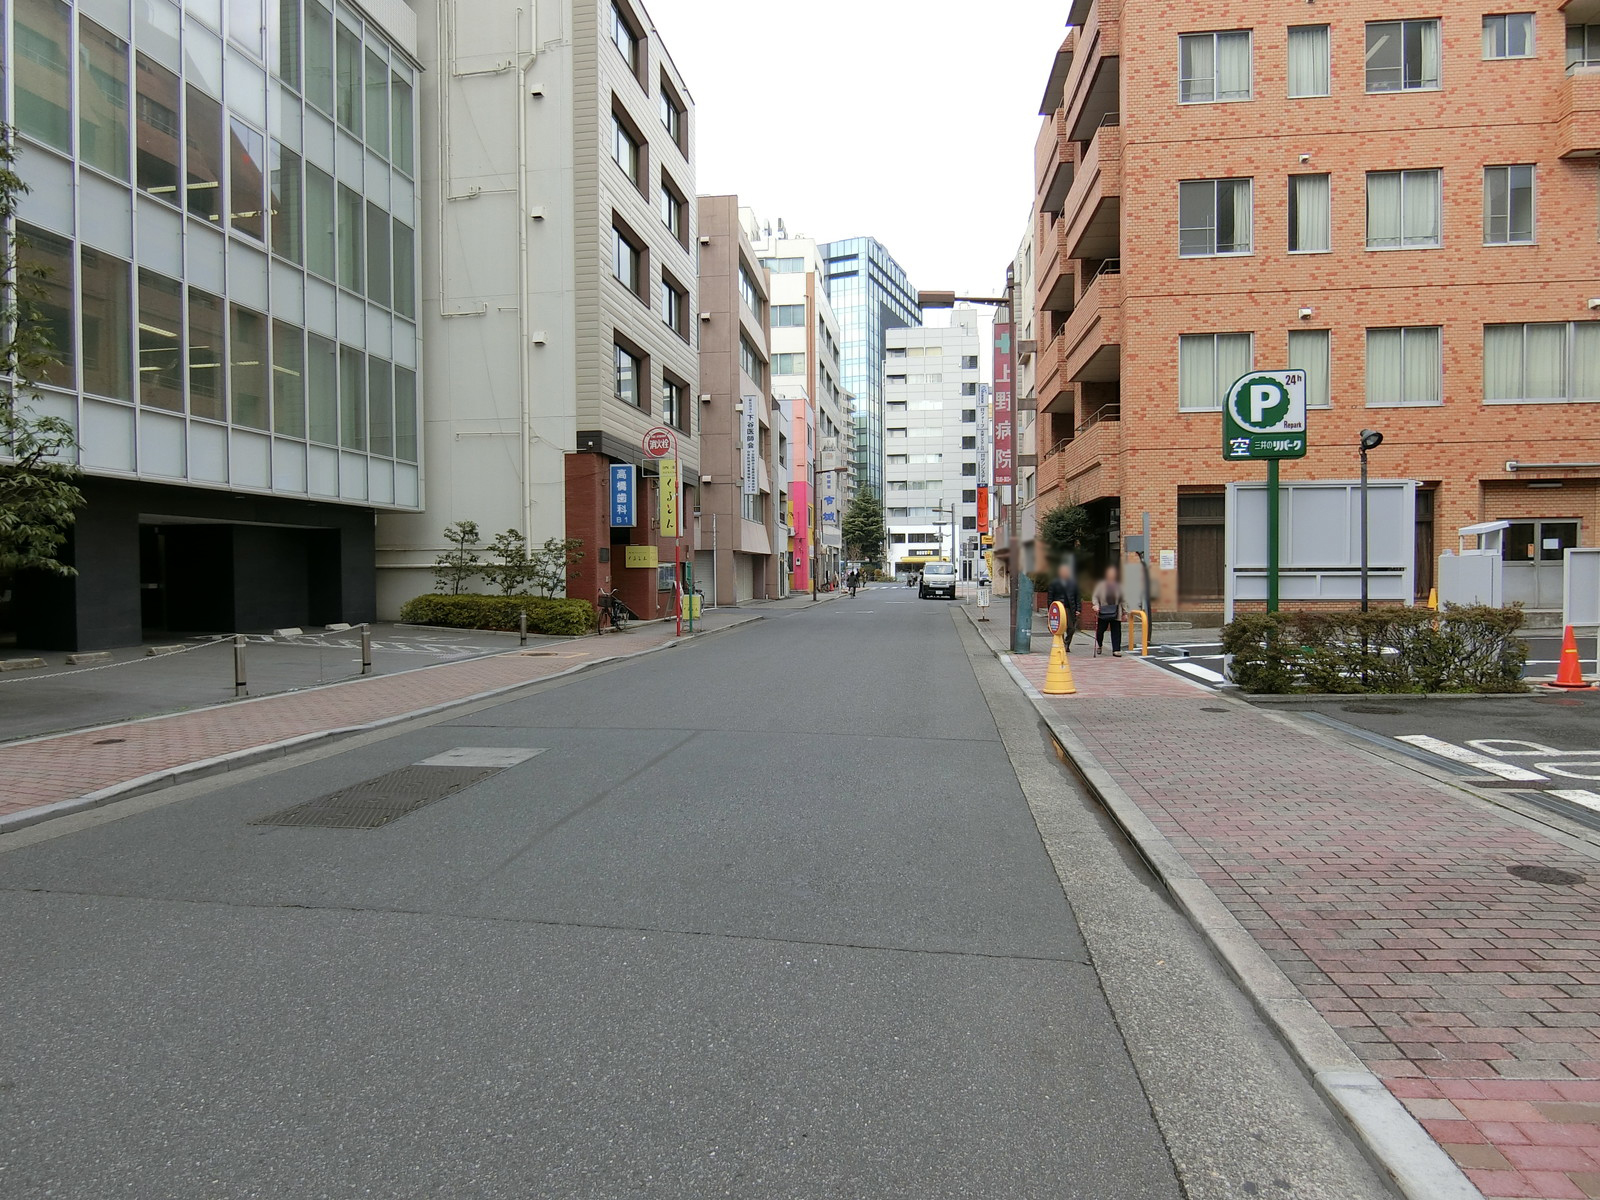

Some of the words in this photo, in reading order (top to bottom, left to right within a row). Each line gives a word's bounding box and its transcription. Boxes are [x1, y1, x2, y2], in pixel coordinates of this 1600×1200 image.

[1285, 374, 1302, 385] 24h
[1250, 384, 1281, 423] P
[995, 364, 1011, 469] 上野病院
[1283, 420, 1302, 429] Repark
[747, 414, 755, 449] 下谷医師会
[650, 438, 669, 450] 消火栓
[1229, 437, 1250, 456] 空
[1254, 439, 1302, 452] 三井のリパーク
[616, 468, 628, 515] 高橋歯科
